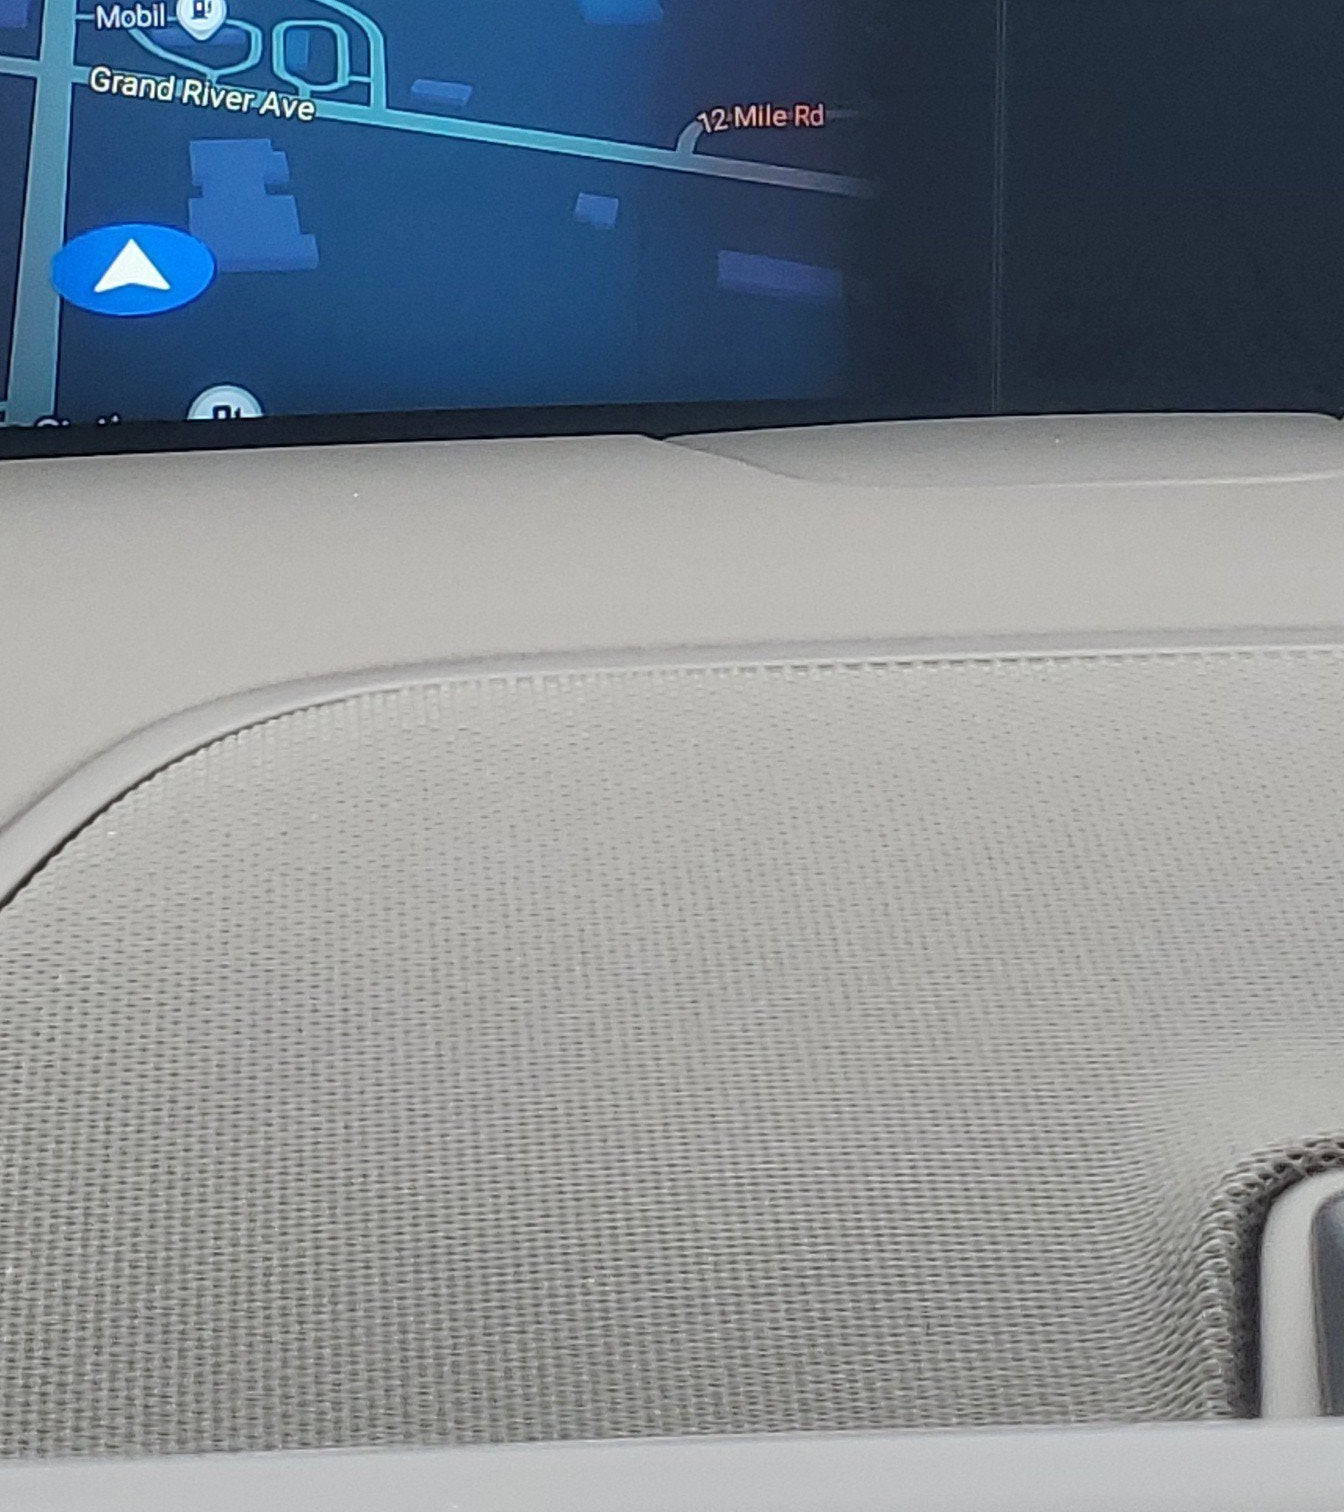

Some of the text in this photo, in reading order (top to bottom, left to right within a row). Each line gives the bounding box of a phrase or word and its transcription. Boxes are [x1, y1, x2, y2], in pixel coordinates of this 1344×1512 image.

[95, 2, 167, 30] Mobil
[89, 66, 316, 122] Grand River Ave
[696, 102, 824, 134] 12 Mile Rd
